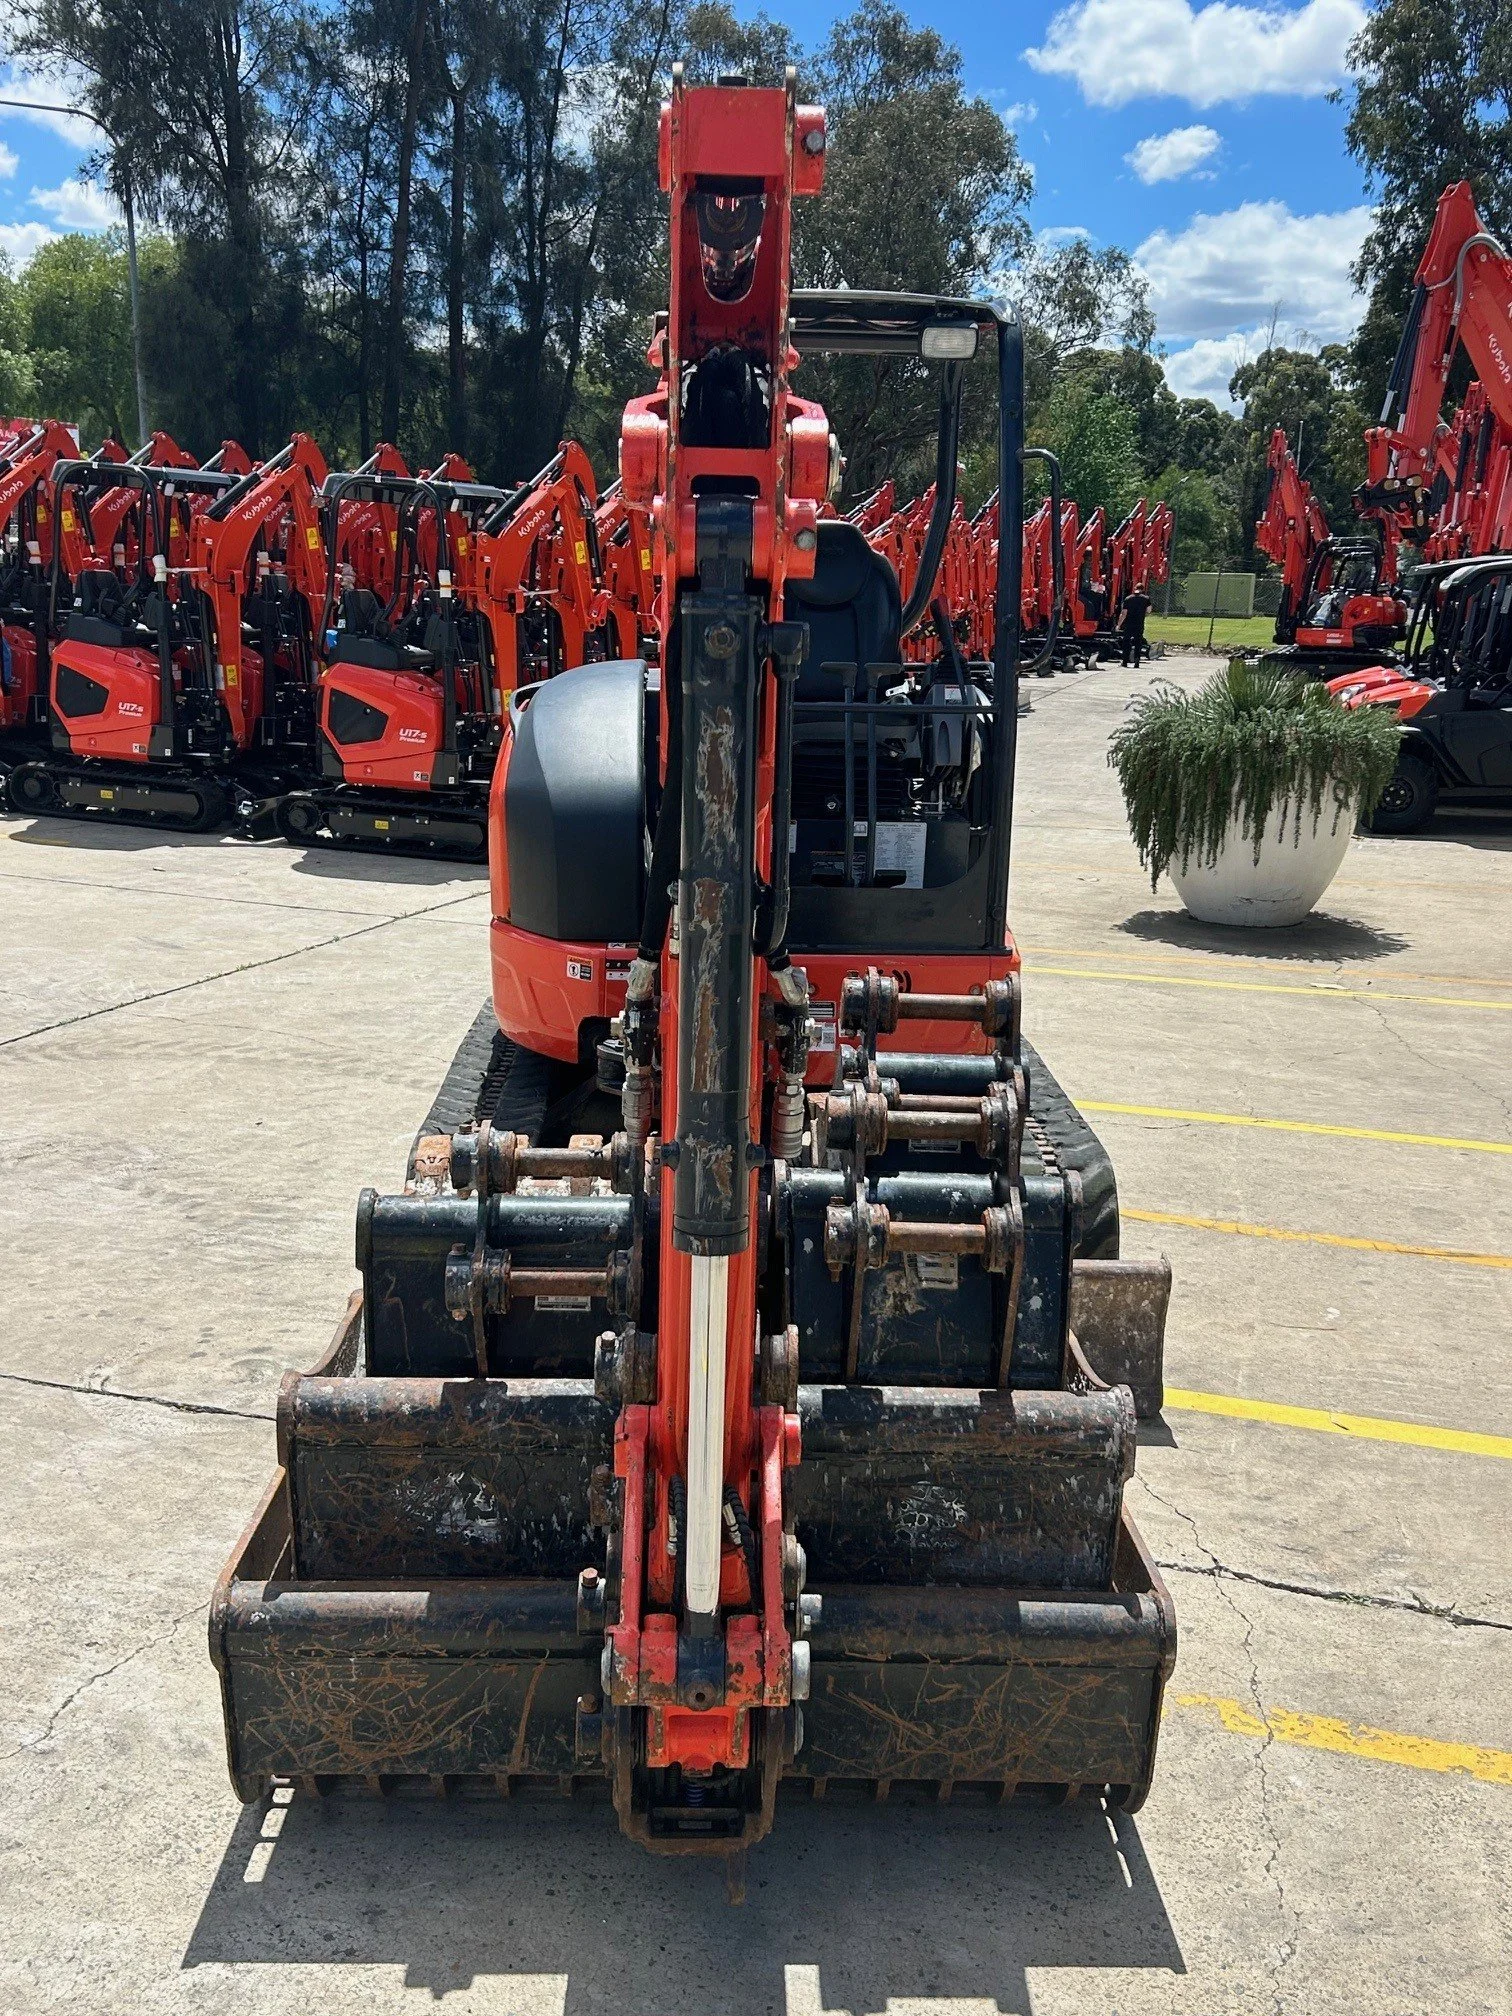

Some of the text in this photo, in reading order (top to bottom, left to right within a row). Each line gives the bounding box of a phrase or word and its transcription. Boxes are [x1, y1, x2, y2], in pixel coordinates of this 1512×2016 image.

[1489, 333, 1511, 384] Kubota
[0, 481, 24, 504] ubota
[107, 489, 135, 512] Kubota
[242, 495, 273, 521] Kubota
[517, 509, 546, 538] Kubota
